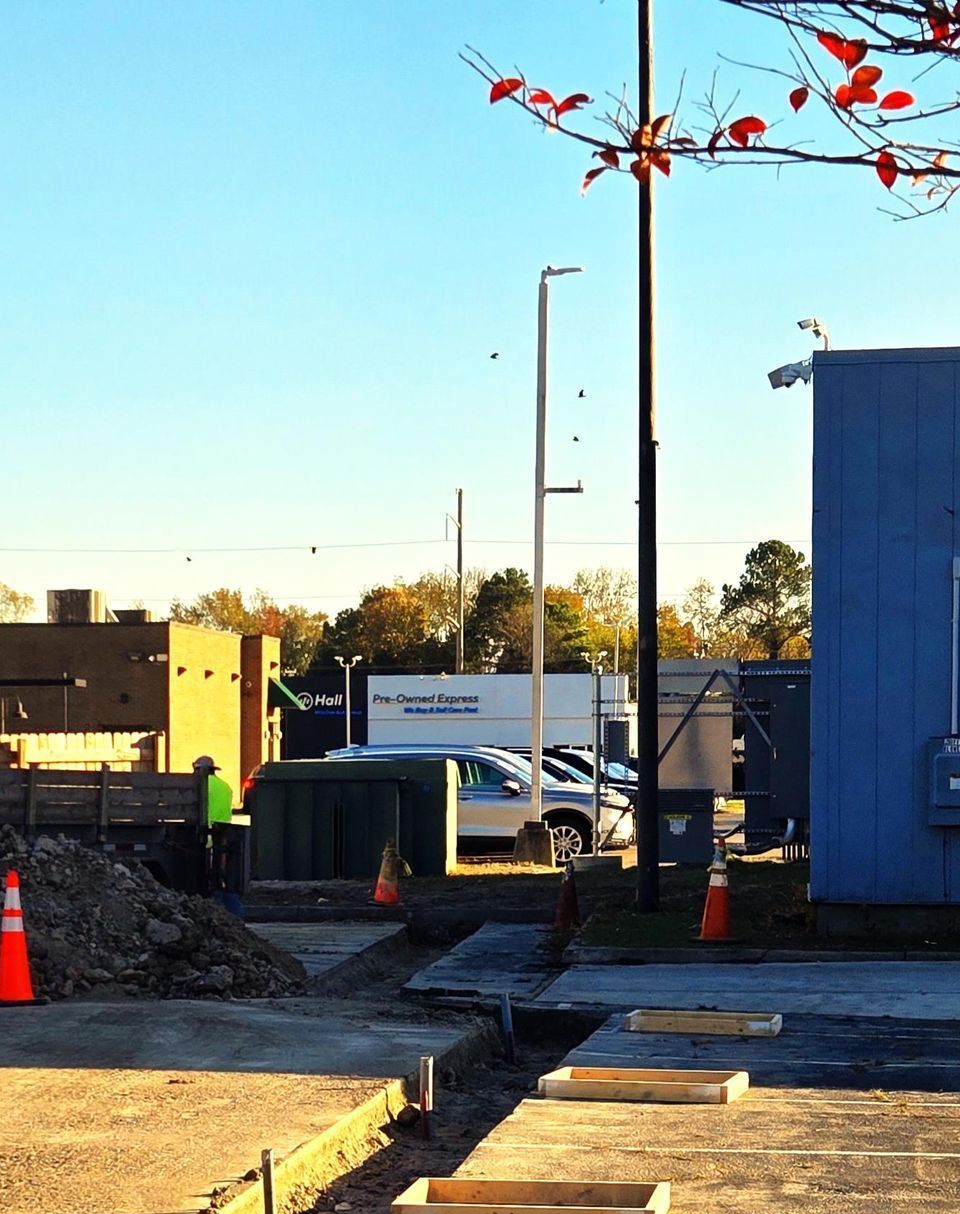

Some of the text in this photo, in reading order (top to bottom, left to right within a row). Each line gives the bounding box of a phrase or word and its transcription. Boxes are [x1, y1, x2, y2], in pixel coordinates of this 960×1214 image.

[315, 693, 343, 707] Hall
[372, 693, 480, 706] Pre-Owned Express
